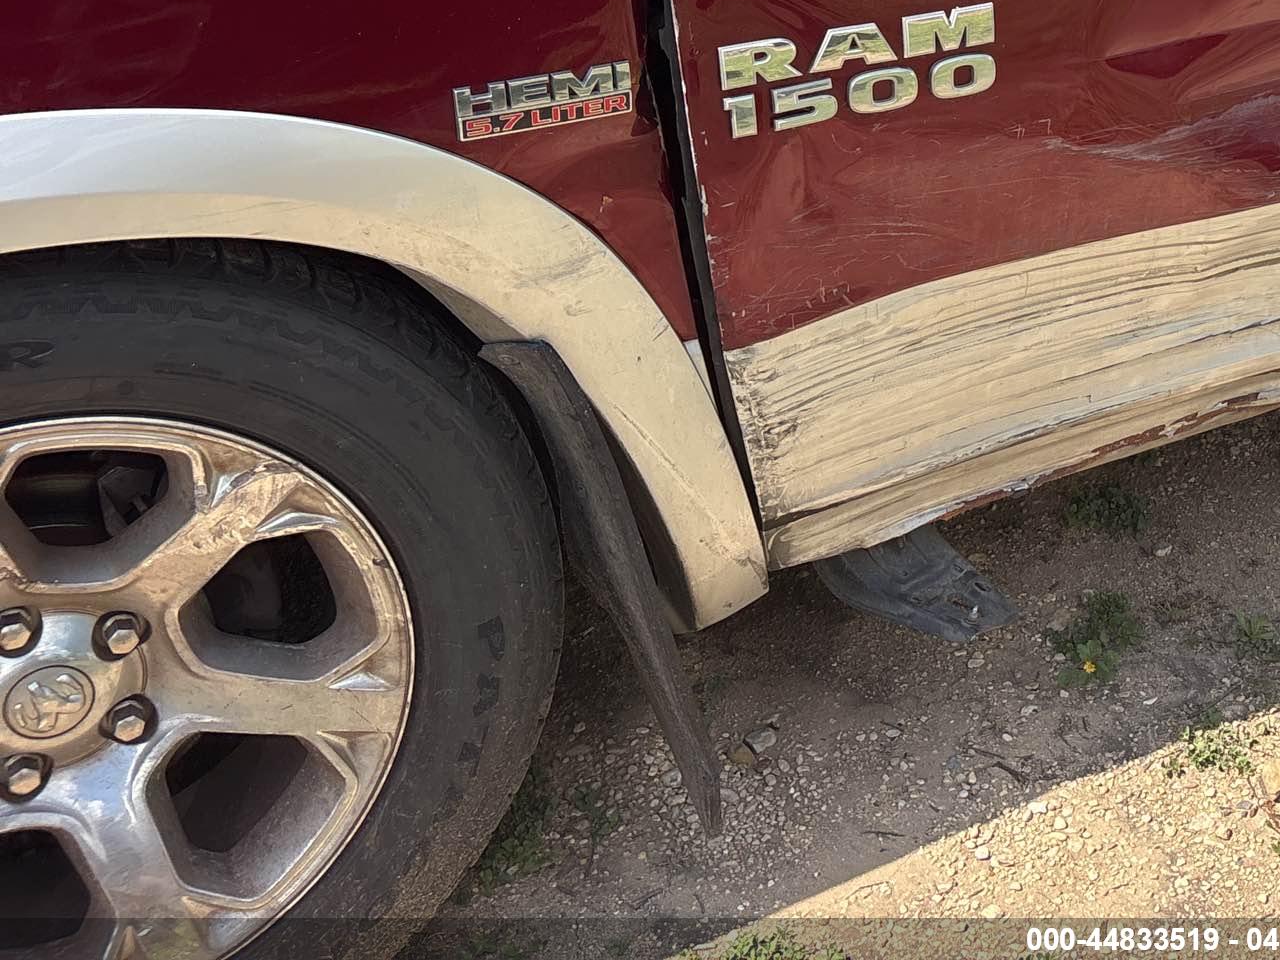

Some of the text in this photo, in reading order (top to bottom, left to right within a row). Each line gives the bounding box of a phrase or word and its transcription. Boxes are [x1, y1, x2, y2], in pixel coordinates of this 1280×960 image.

[718, 2, 996, 91] RAM
[453, 60, 631, 118] HEMI
[466, 94, 627, 137] 5.7 LITER
[723, 53, 997, 139] 1500
